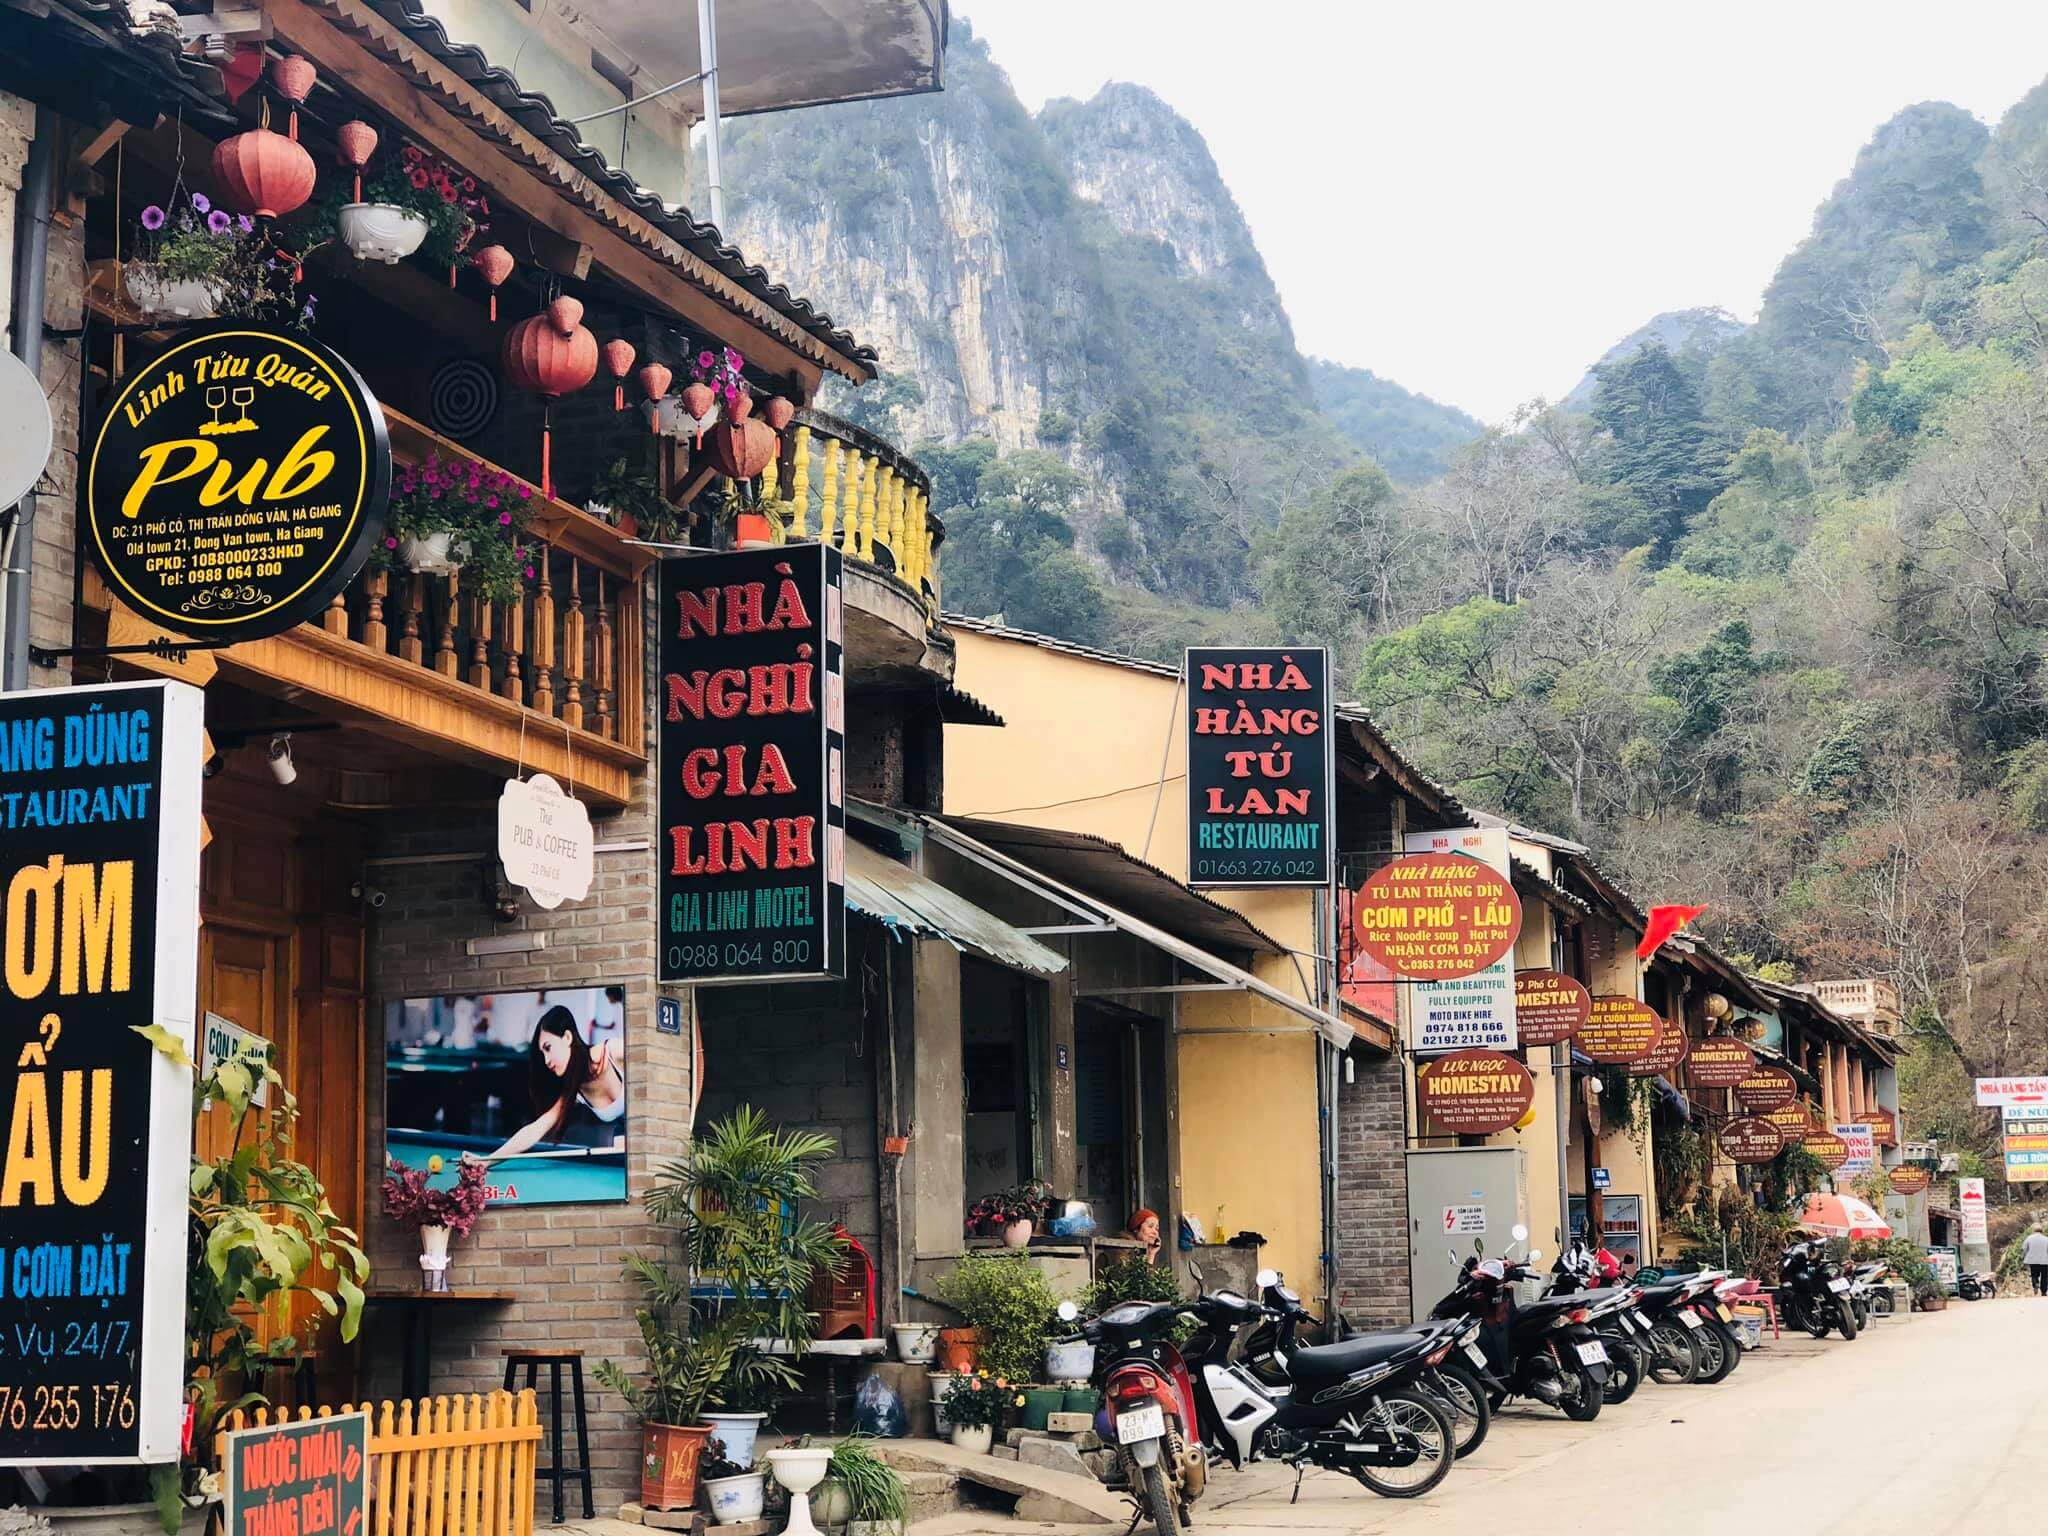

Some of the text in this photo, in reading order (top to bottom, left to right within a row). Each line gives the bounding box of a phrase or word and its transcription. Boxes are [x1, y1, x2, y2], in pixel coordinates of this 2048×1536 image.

[124, 350, 331, 428] Linh Tửu Quán
[121, 425, 335, 519] Pub
[132, 525, 143, 537] 21
[188, 519, 203, 534] THỊ
[293, 504, 307, 519] HÀ
[309, 504, 342, 519] GIANG
[126, 526, 324, 556] Old town 21, Dong Van town, Ha Giang
[159, 562, 282, 586] Tel: 0988 064 800
[677, 561, 813, 640] NHÀ
[665, 642, 815, 723] NGHỈ
[1201, 655, 1312, 691] NHÀ
[1195, 699, 1320, 735] HÀNG
[64, 703, 150, 769] DŨNG
[681, 743, 797, 800] GIA
[1225, 741, 1293, 778] TÚ
[1206, 787, 1311, 816] LAN
[513, 824, 533, 847] PUB
[543, 834, 579, 860] COFFEE
[669, 815, 816, 877] LINH
[1199, 822, 1320, 849] RESTAURANT
[1198, 860, 1315, 876] 01663 276 042
[1390, 862, 1480, 881] NHÀ HÀNG
[1371, 883, 1389, 900] TÚ
[1394, 886, 1420, 899] LAN
[1424, 879, 1473, 899] THẮNG
[670, 885, 814, 932] GIA LINH MOTEL
[1362, 906, 1407, 929] CƠM
[1413, 899, 1455, 927] PHỞ
[1474, 897, 1512, 927] LẨU
[1369, 929, 1508, 944] Rice Noodle soup Hot Pot
[1385, 942, 1491, 959] NHẬN CƠM ĐẶT
[668, 940, 809, 969] 0988 064 800
[1411, 959, 1475, 970] 0363 276 042
[1444, 981, 1461, 991] AND
[1463, 980, 1506, 990] BEAUTYFUL
[663, 1005, 674, 1025] 21
[1429, 995, 1493, 1006] FULLY EQUIPPED
[1430, 1010, 1492, 1021] MOTO BIKE HIRE
[1457, 1022, 1478, 1032] 818
[1481, 1022, 1503, 1031] 666
[209, 1023, 229, 1059] CÒN
[1423, 1034, 1507, 1045] 02192 213 666
[1470, 1059, 1507, 1075] NGỌC
[1691, 1051, 1748, 1062] HOMESTAY
[1428, 1075, 1522, 1095] HOMESTAY
[0, 1012, 112, 1207] ẨU
[1749, 1134, 1779, 1144] COFFEE
[483, 1184, 519, 1200] Bi-A
[13, 1232, 132, 1308] CƠM ĐẶT
[14, 1320, 131, 1364] Vụ 24/7
[33, 1385, 80, 1430] 255
[92, 1384, 135, 1430] 176
[243, 1424, 338, 1492] NƯỚC MÍA
